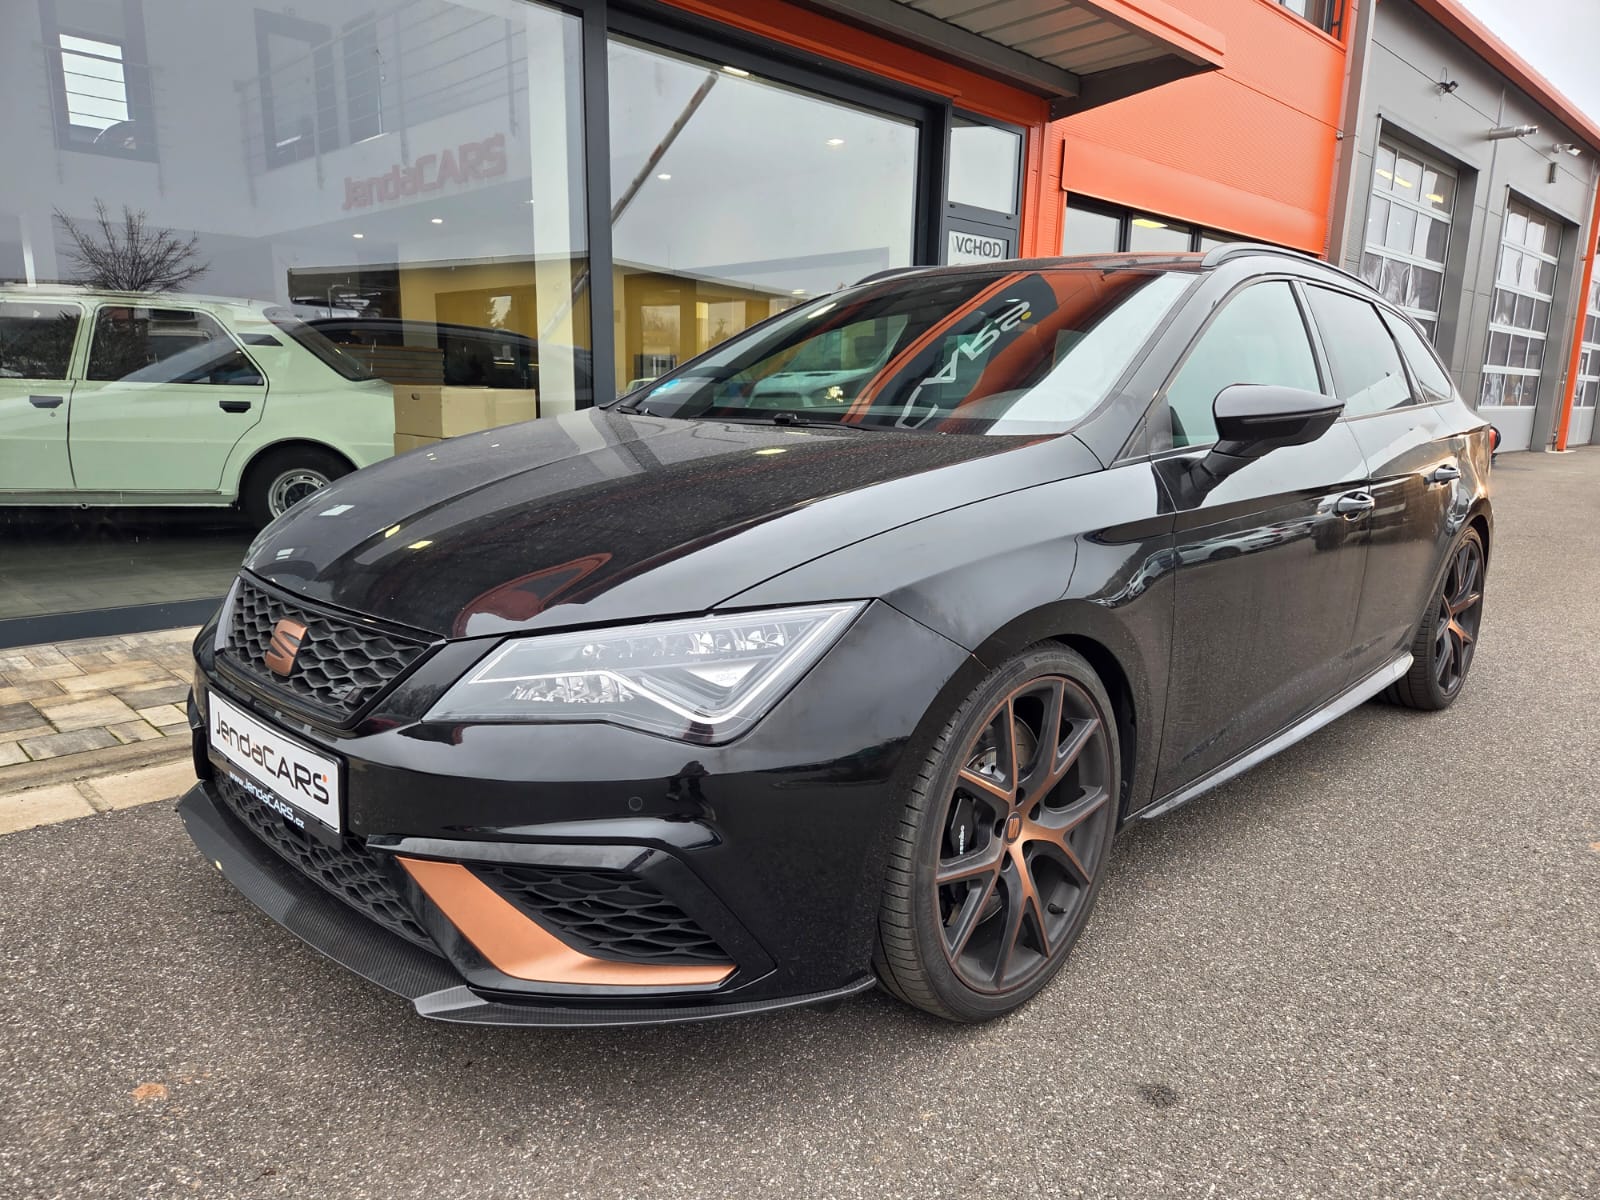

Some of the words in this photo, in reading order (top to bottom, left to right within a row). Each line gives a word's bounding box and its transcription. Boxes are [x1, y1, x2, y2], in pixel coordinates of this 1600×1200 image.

[342, 133, 507, 211] JendaCARS
[955, 235, 1002, 258] VCHOD
[216, 711, 329, 804] JendaCARS
